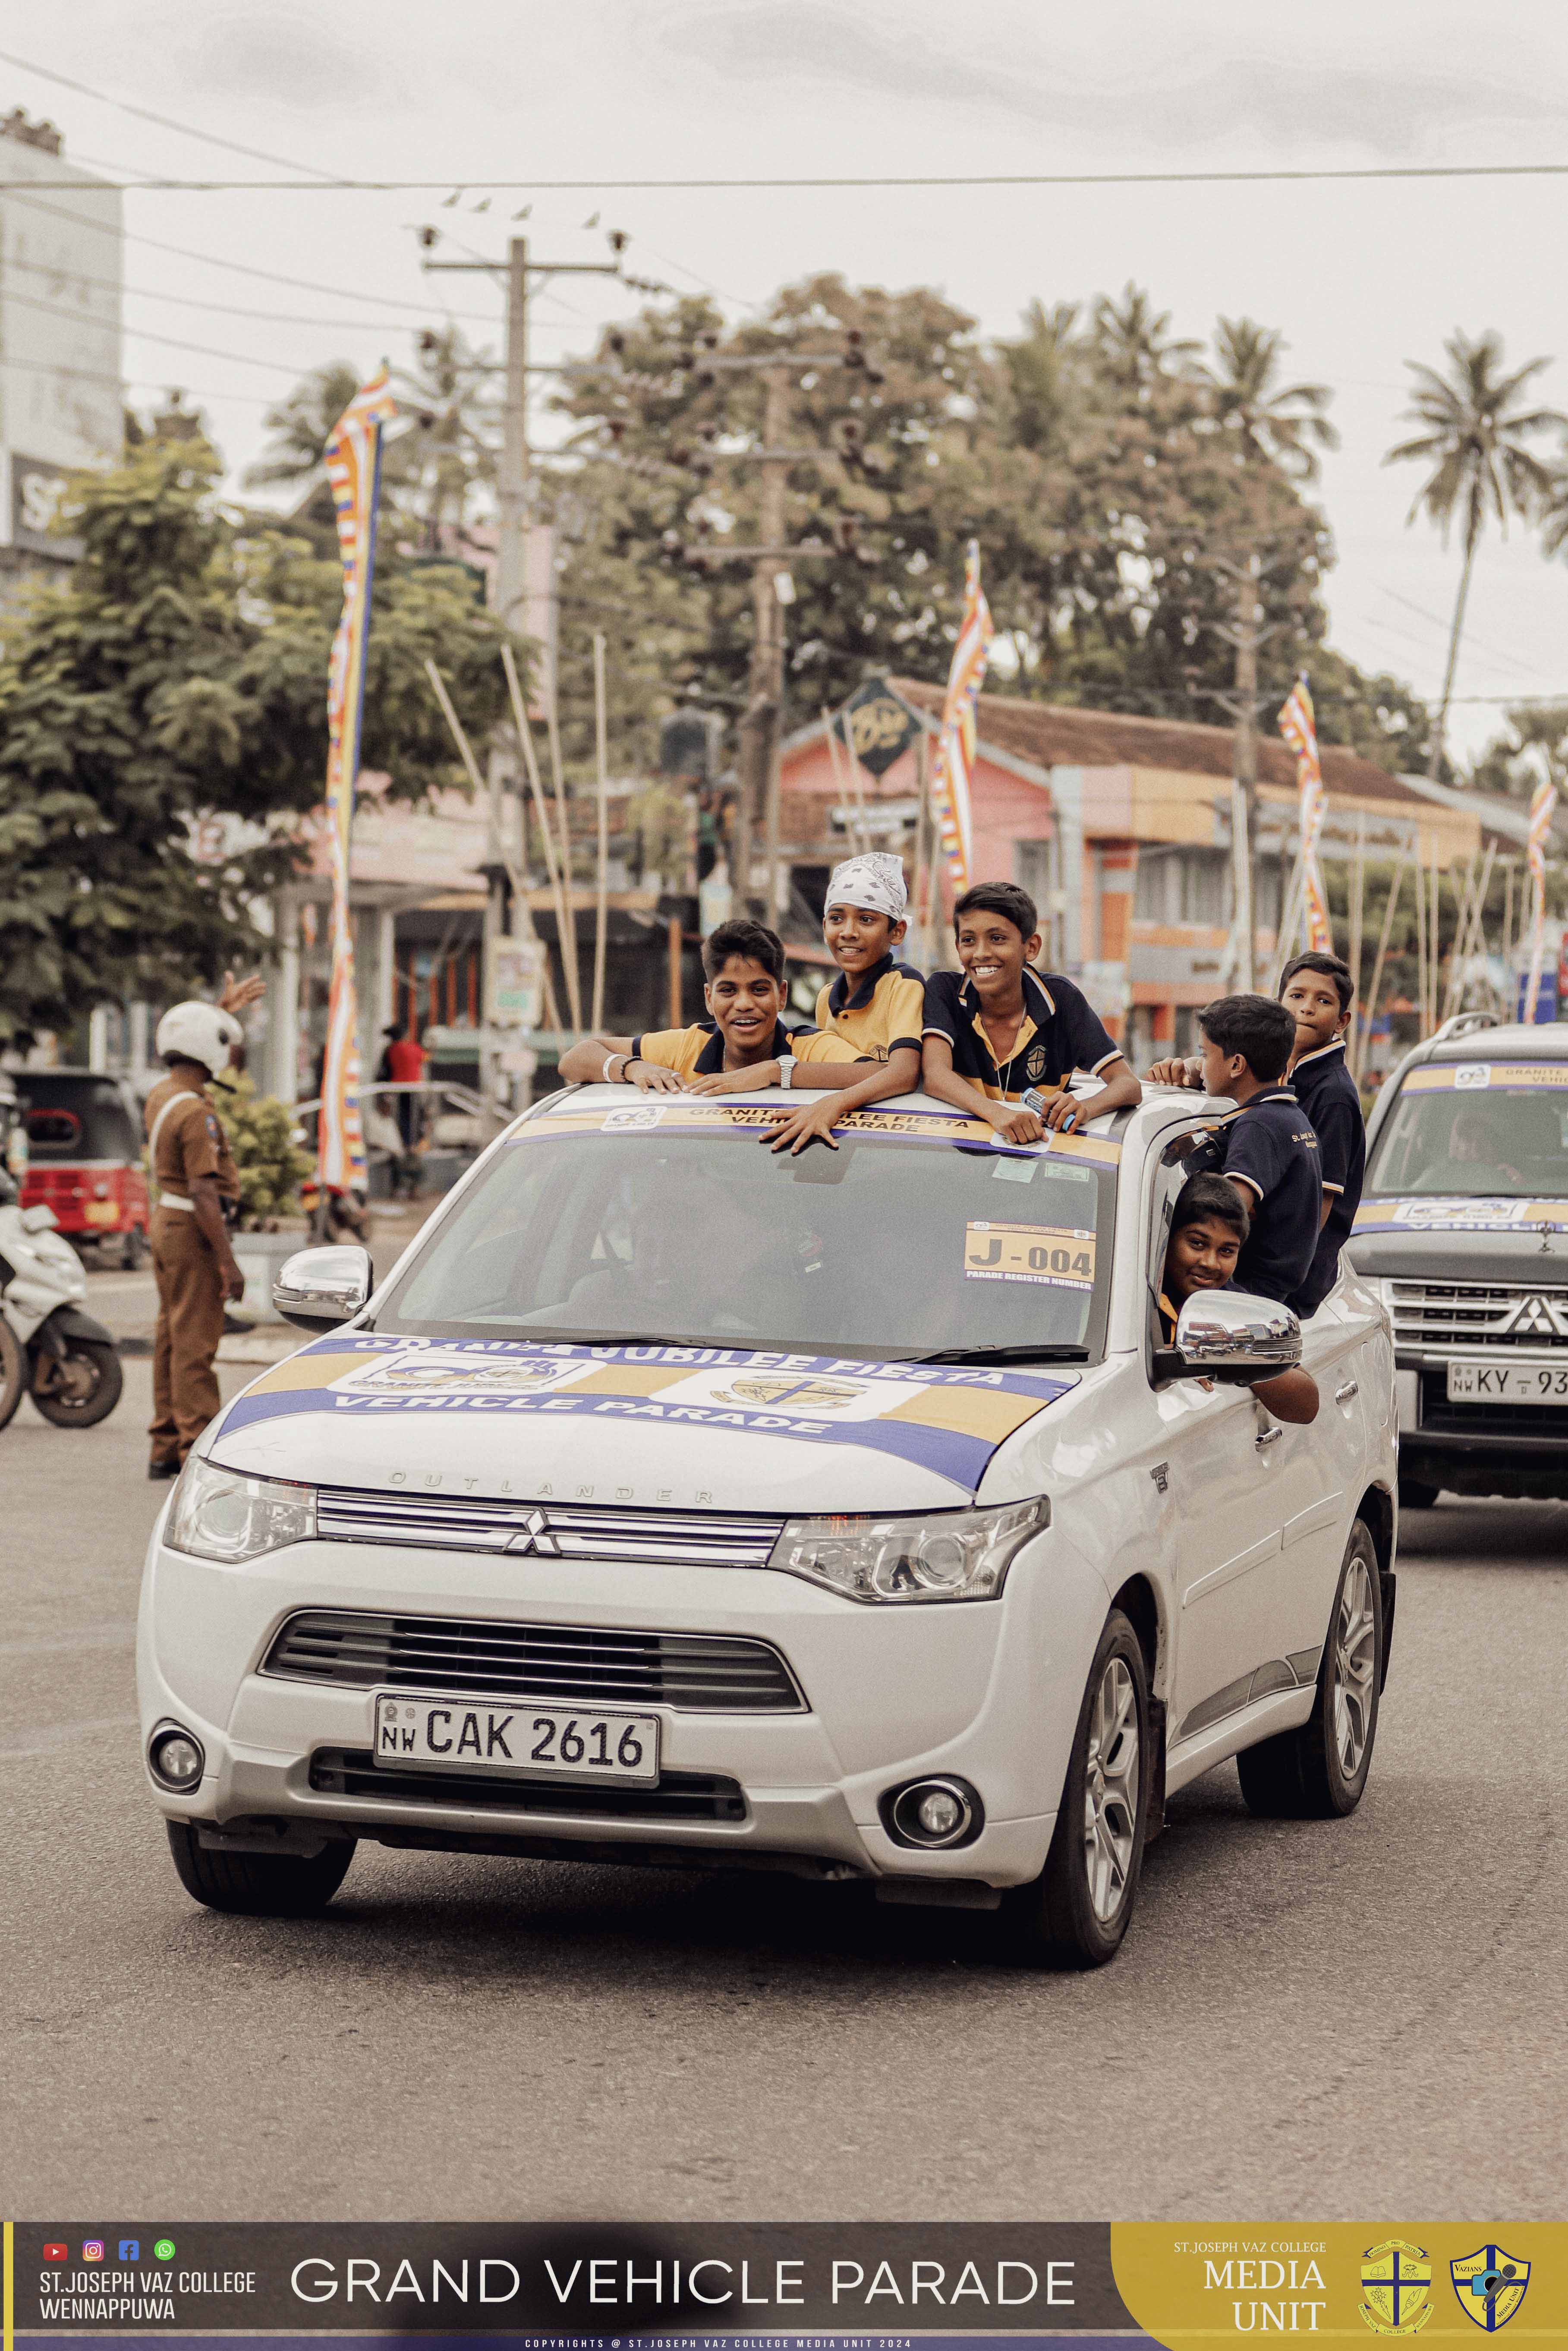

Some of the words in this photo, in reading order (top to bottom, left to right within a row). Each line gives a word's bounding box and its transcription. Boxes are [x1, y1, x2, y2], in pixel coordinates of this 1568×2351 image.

[690, 1108, 780, 1116] GRANIT
[839, 1112, 888, 1122] ILEE
[894, 1116, 970, 1128] FIESTA
[833, 1119, 919, 1132] PARADE
[966, 1270, 1003, 1279] PARADE
[1004, 1273, 1050, 1284] REGISTER
[1051, 1277, 1092, 1290] NUMBER
[822, 1359, 1004, 1385] FIESTA
[1454, 1380, 1472, 1392] NW
[1478, 1369, 1509, 1393] KY
[335, 1396, 584, 1411] VEHICLE
[592, 1400, 833, 1435] PARADE
[389, 1471, 713, 1504] OUTLANDER
[382, 1726, 416, 1752] NW
[427, 1709, 514, 1758] CAK
[531, 1718, 643, 1767] 2616
